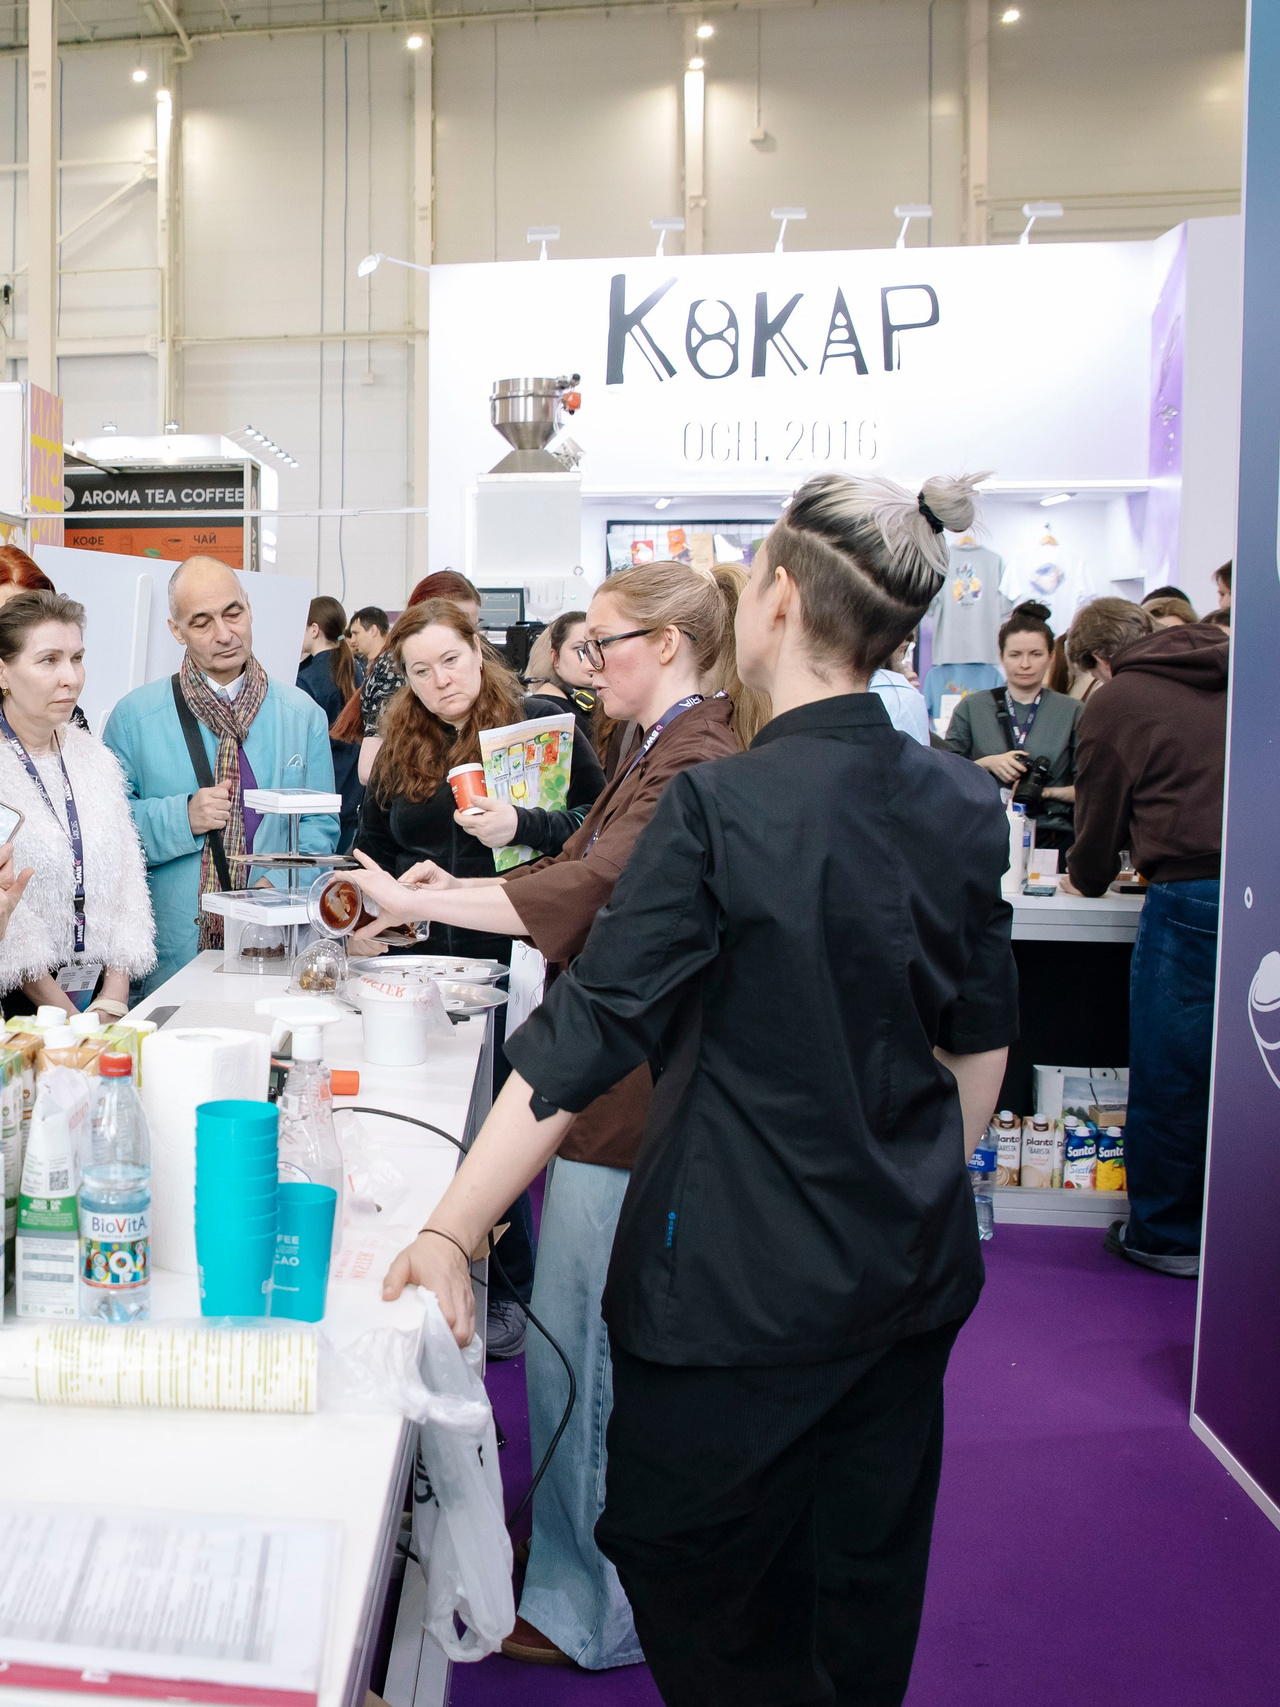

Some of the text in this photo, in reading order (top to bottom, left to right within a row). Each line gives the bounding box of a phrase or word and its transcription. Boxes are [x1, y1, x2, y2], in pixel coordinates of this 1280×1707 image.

[785, 420, 877, 461] 2016
[81, 487, 244, 504] AROMA TEA COFFEE
[73, 536, 104, 546] КОФЕ
[193, 531, 217, 544] ЧАЙ
[643, 729, 660, 751] BWT
[1029, 1146, 1051, 1155] BARISTA
[1067, 1144, 1097, 1157] Santal
